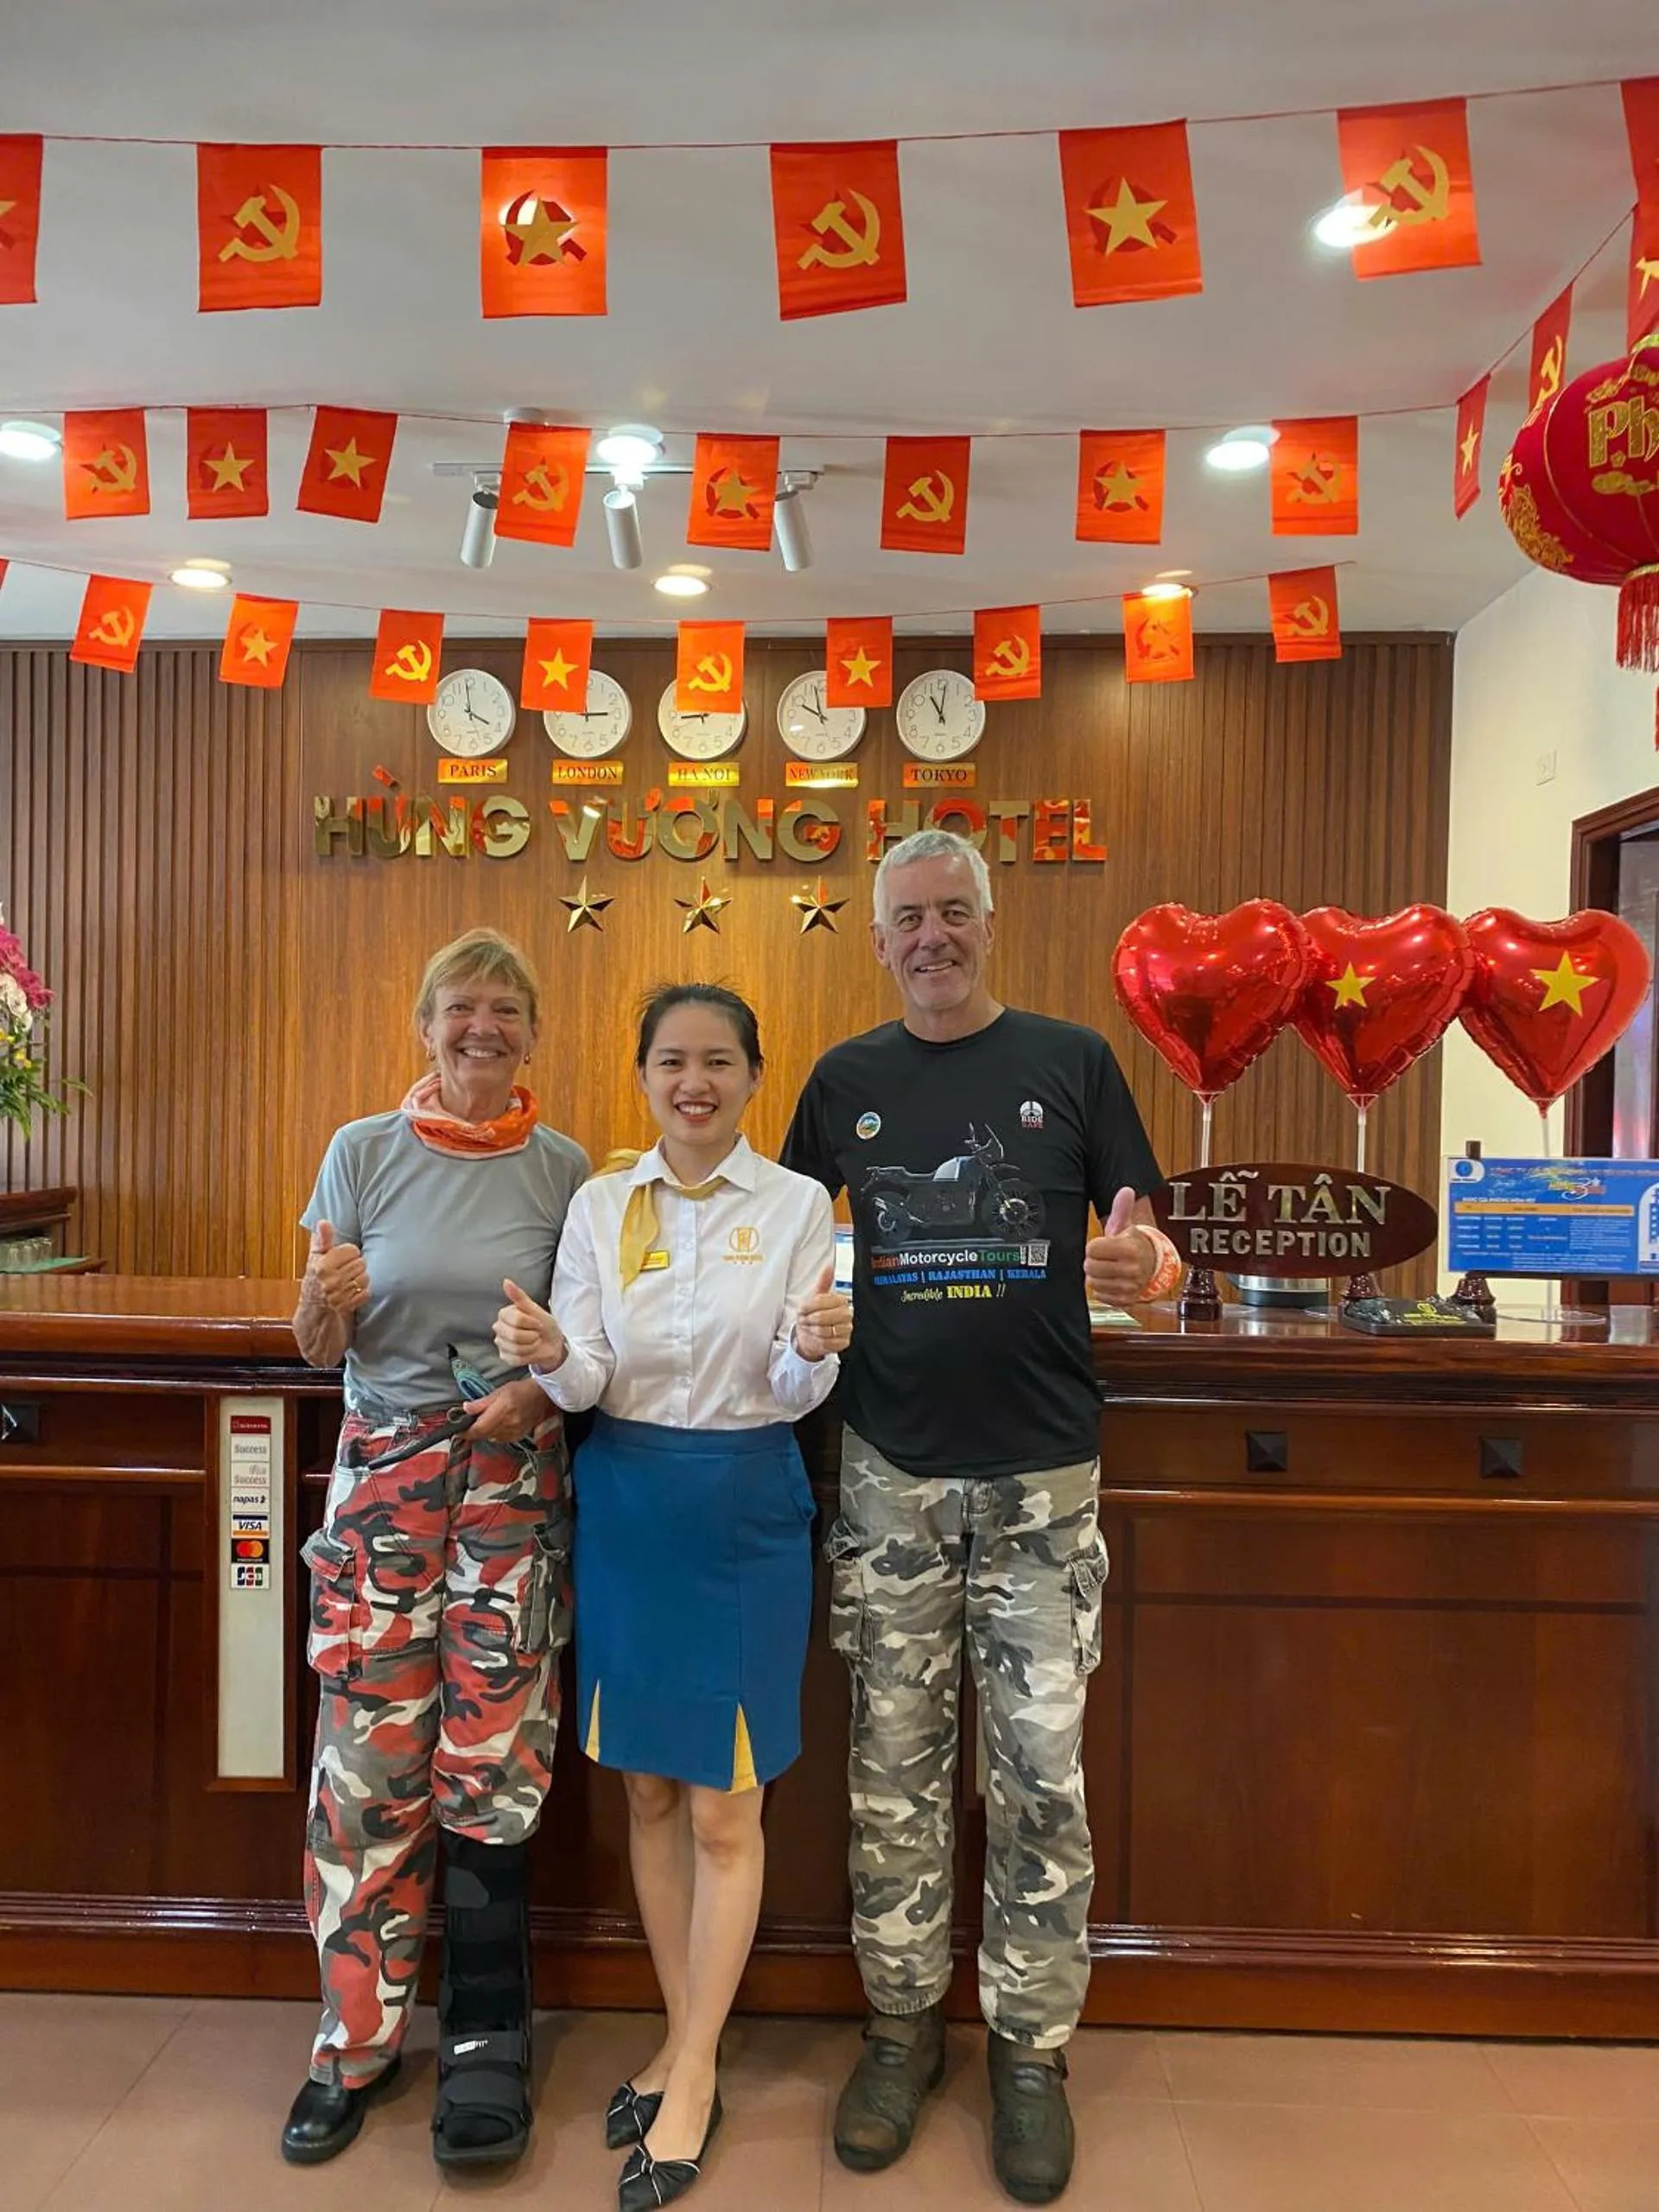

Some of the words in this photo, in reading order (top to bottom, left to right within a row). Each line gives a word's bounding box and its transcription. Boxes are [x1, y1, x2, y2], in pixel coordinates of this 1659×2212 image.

[450, 765, 497, 778] PARIS
[557, 766, 618, 779] LONDON
[789, 768, 814, 781] NEW
[912, 768, 967, 782] TOKYO
[313, 765, 531, 858] HÙNG
[549, 787, 842, 861] VƯƠNG
[867, 798, 1108, 864] HOTEL
[1167, 1170, 1259, 1222] LỄ
[1267, 1173, 1392, 1225] TÂN
[1189, 1227, 1371, 1258] RECEPTION
[928, 1268, 996, 1282] RAJASTHAN
[1007, 1268, 1046, 1280] KERALA
[946, 1284, 993, 1299] INDIA
[233, 1445, 267, 1455] Success
[233, 1475, 267, 1485] Success
[238, 1522, 262, 1530] VISA
